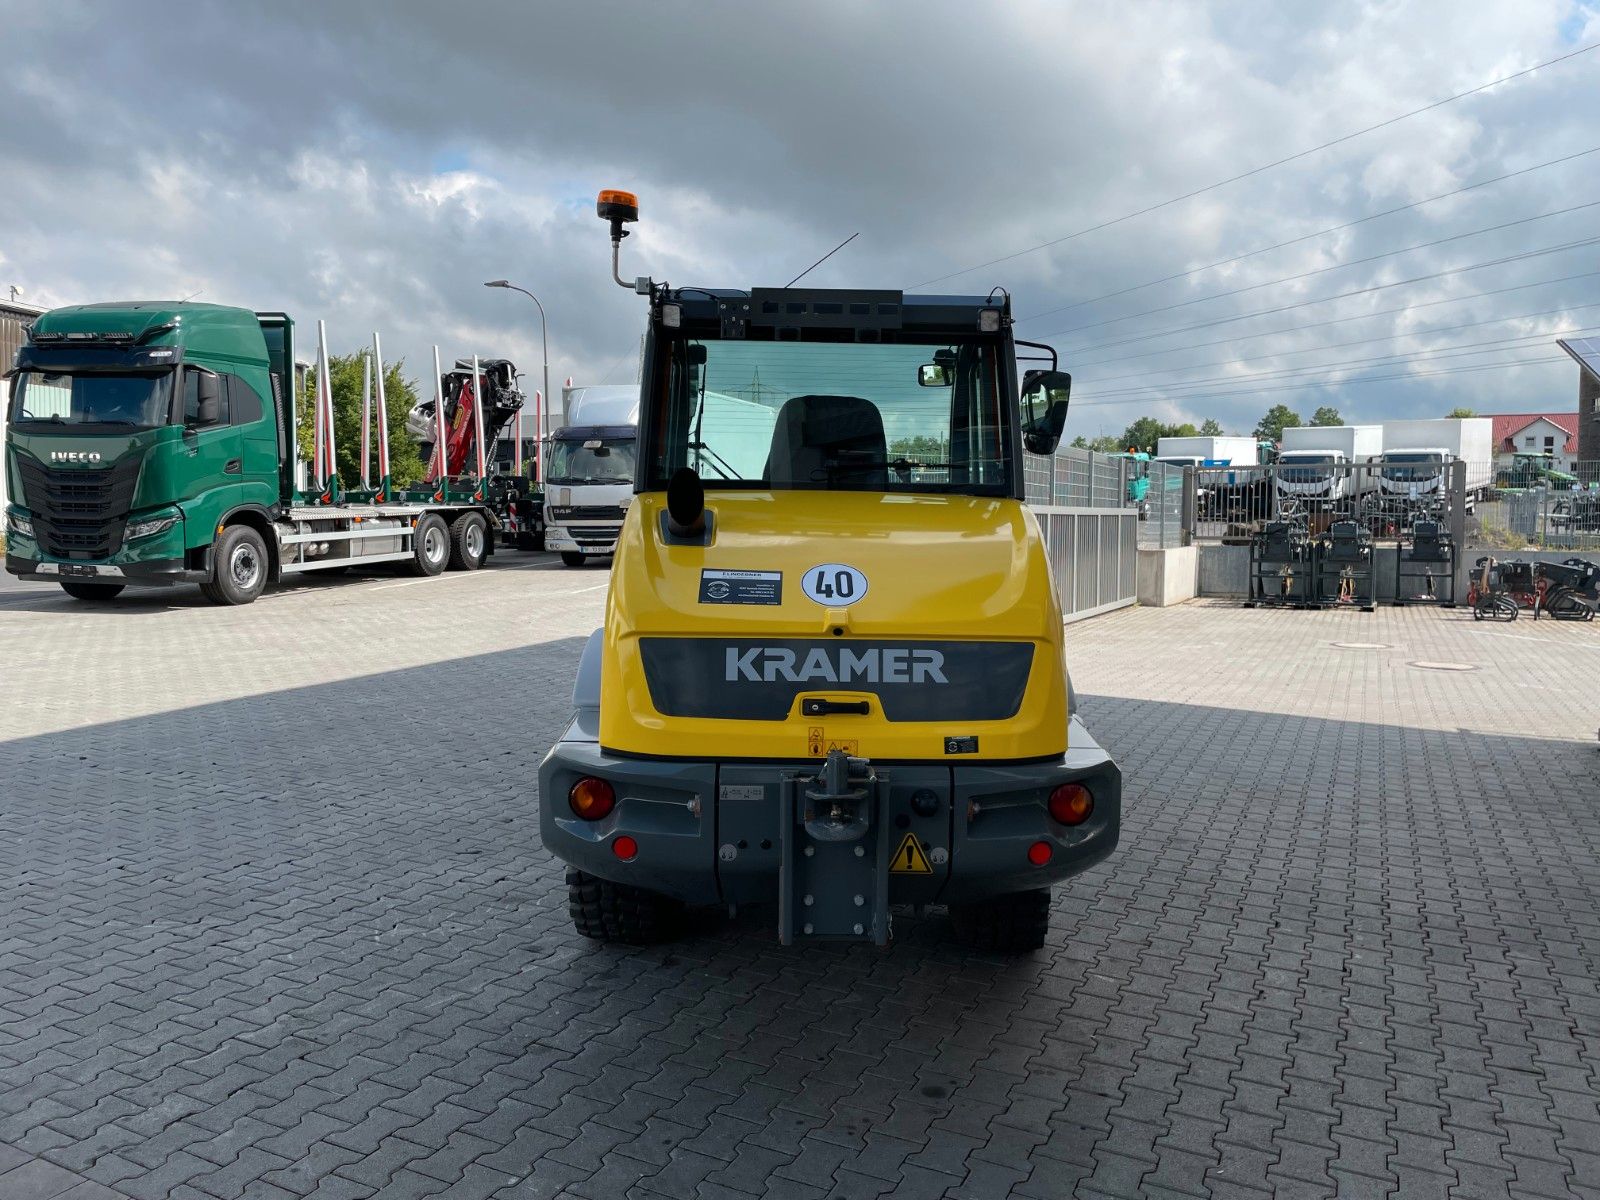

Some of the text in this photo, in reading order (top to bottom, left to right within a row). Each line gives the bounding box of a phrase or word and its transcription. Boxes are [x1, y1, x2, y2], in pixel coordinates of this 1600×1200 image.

[51, 451, 101, 463] IVECO
[815, 570, 854, 599] 40
[725, 647, 949, 683] KRAMER
